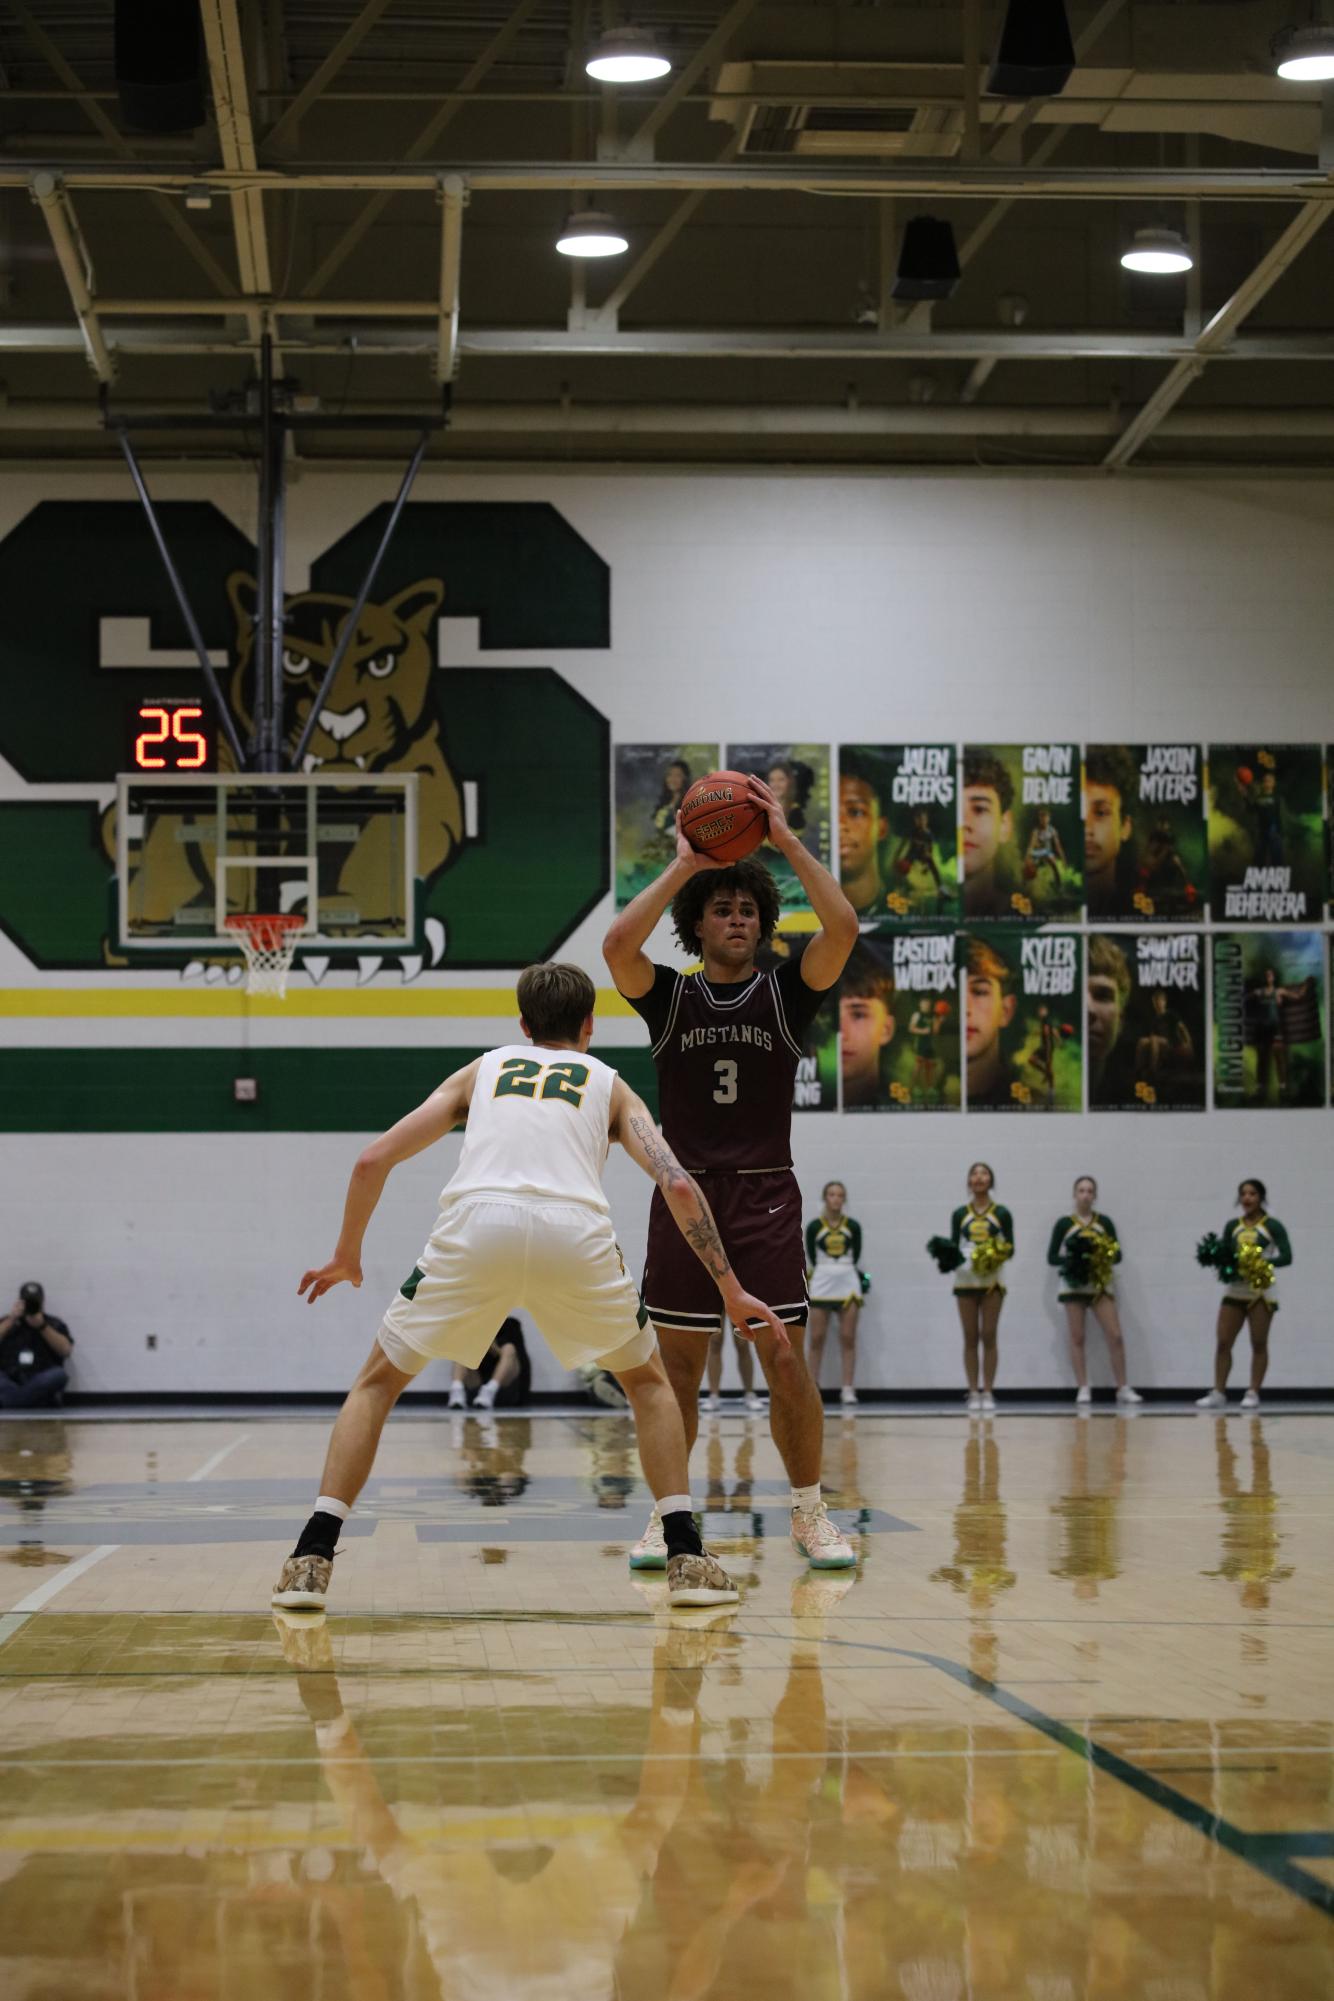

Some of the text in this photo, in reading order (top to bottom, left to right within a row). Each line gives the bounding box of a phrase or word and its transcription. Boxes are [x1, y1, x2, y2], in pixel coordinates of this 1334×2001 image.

[136, 708, 207, 768] 25
[897, 746, 951, 776] JALEN
[1022, 745, 1073, 775] GAVIN
[1139, 745, 1198, 774] JAXON
[892, 775, 955, 808] CHEEKS
[1022, 775, 1074, 806] DEVOE
[1138, 774, 1199, 806] MYERS
[1243, 865, 1292, 893] AMARI
[1225, 892, 1308, 922] DEHERRERA
[893, 935, 956, 964] EASTON
[1021, 937, 1077, 969] KYLER
[1136, 935, 1199, 962] SAWYER
[893, 963, 957, 993] WILCOX
[1022, 966, 1075, 995] WEBB
[1138, 962, 1199, 990] WALKER
[680, 1024, 773, 1053] MUSTANGS
[493, 1058, 592, 1110] 22
[712, 1059, 738, 1104] 3
